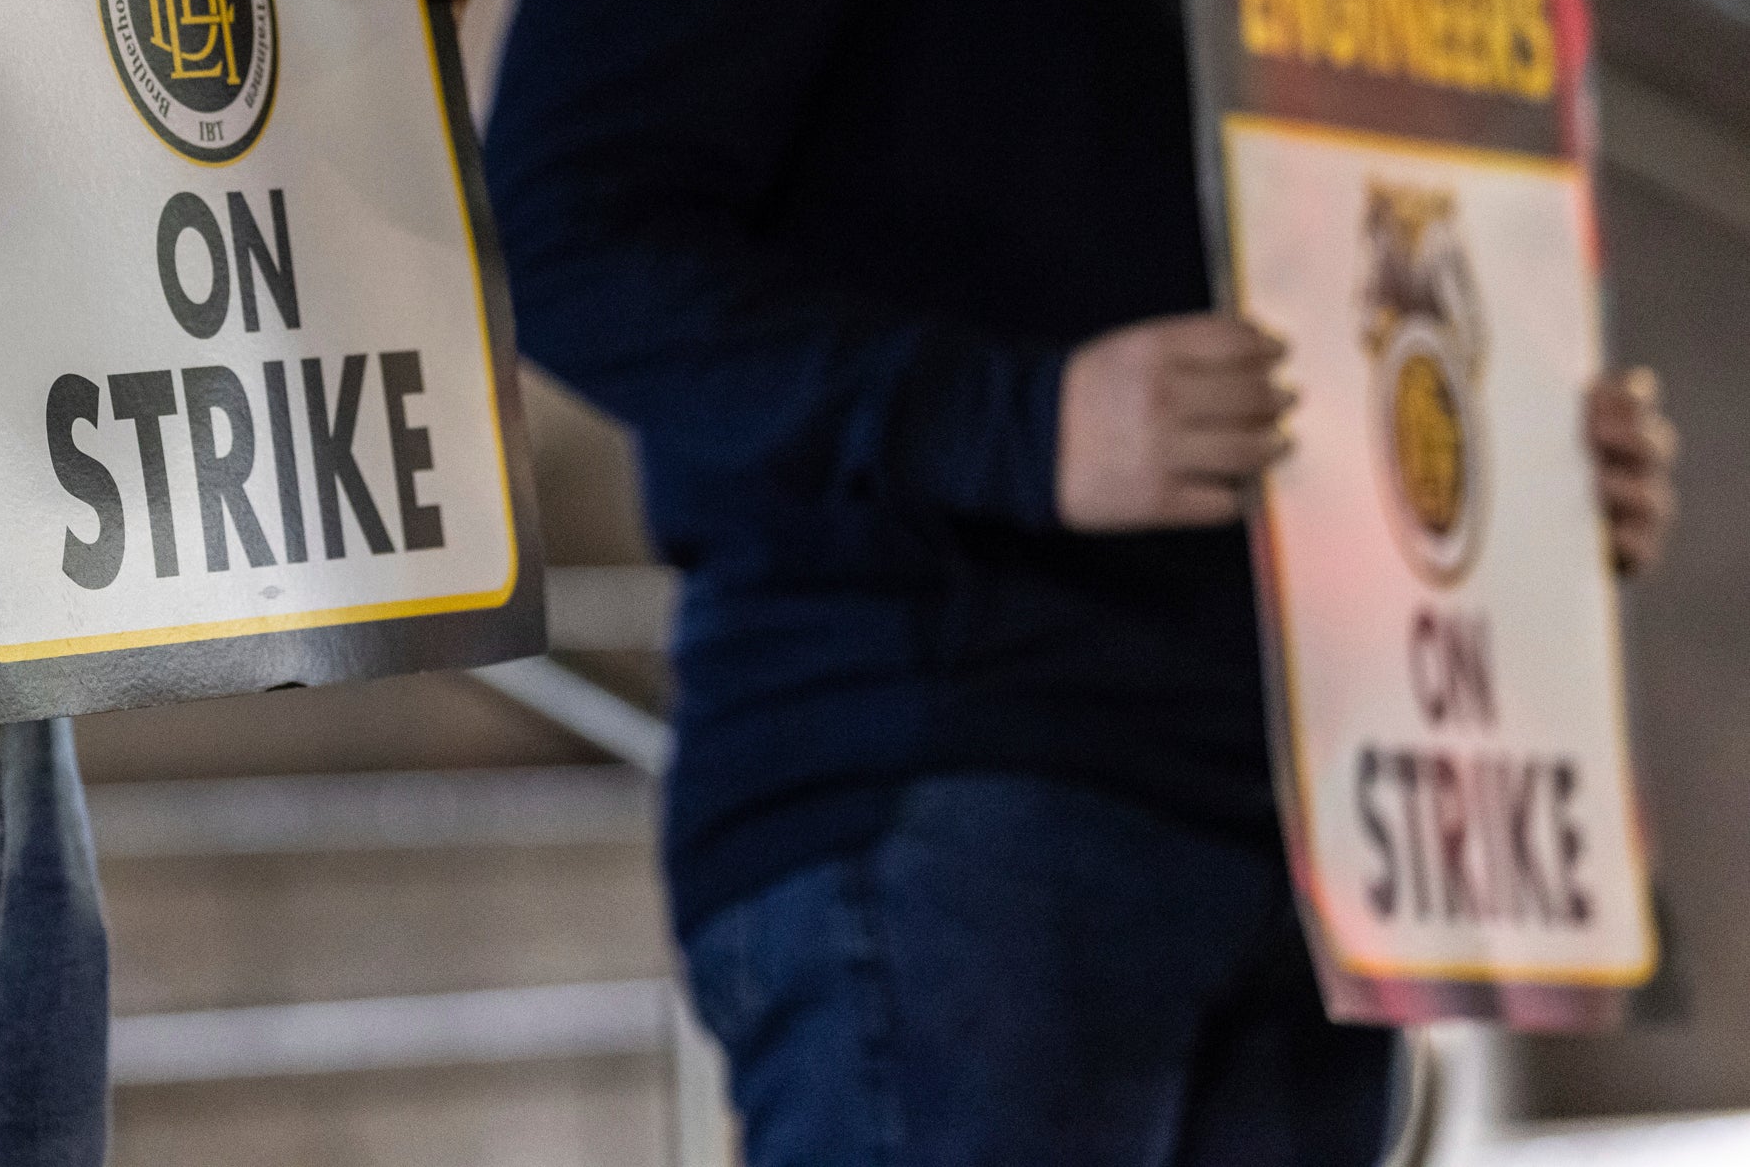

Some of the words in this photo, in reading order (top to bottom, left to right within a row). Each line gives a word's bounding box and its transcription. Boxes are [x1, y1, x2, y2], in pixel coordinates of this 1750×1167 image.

[198, 120, 225, 142] IBT
[156, 187, 302, 340] ON
[45, 348, 447, 591] STRIKE
[1408, 607, 1497, 731] ON
[1354, 747, 1595, 929] STRIKE
